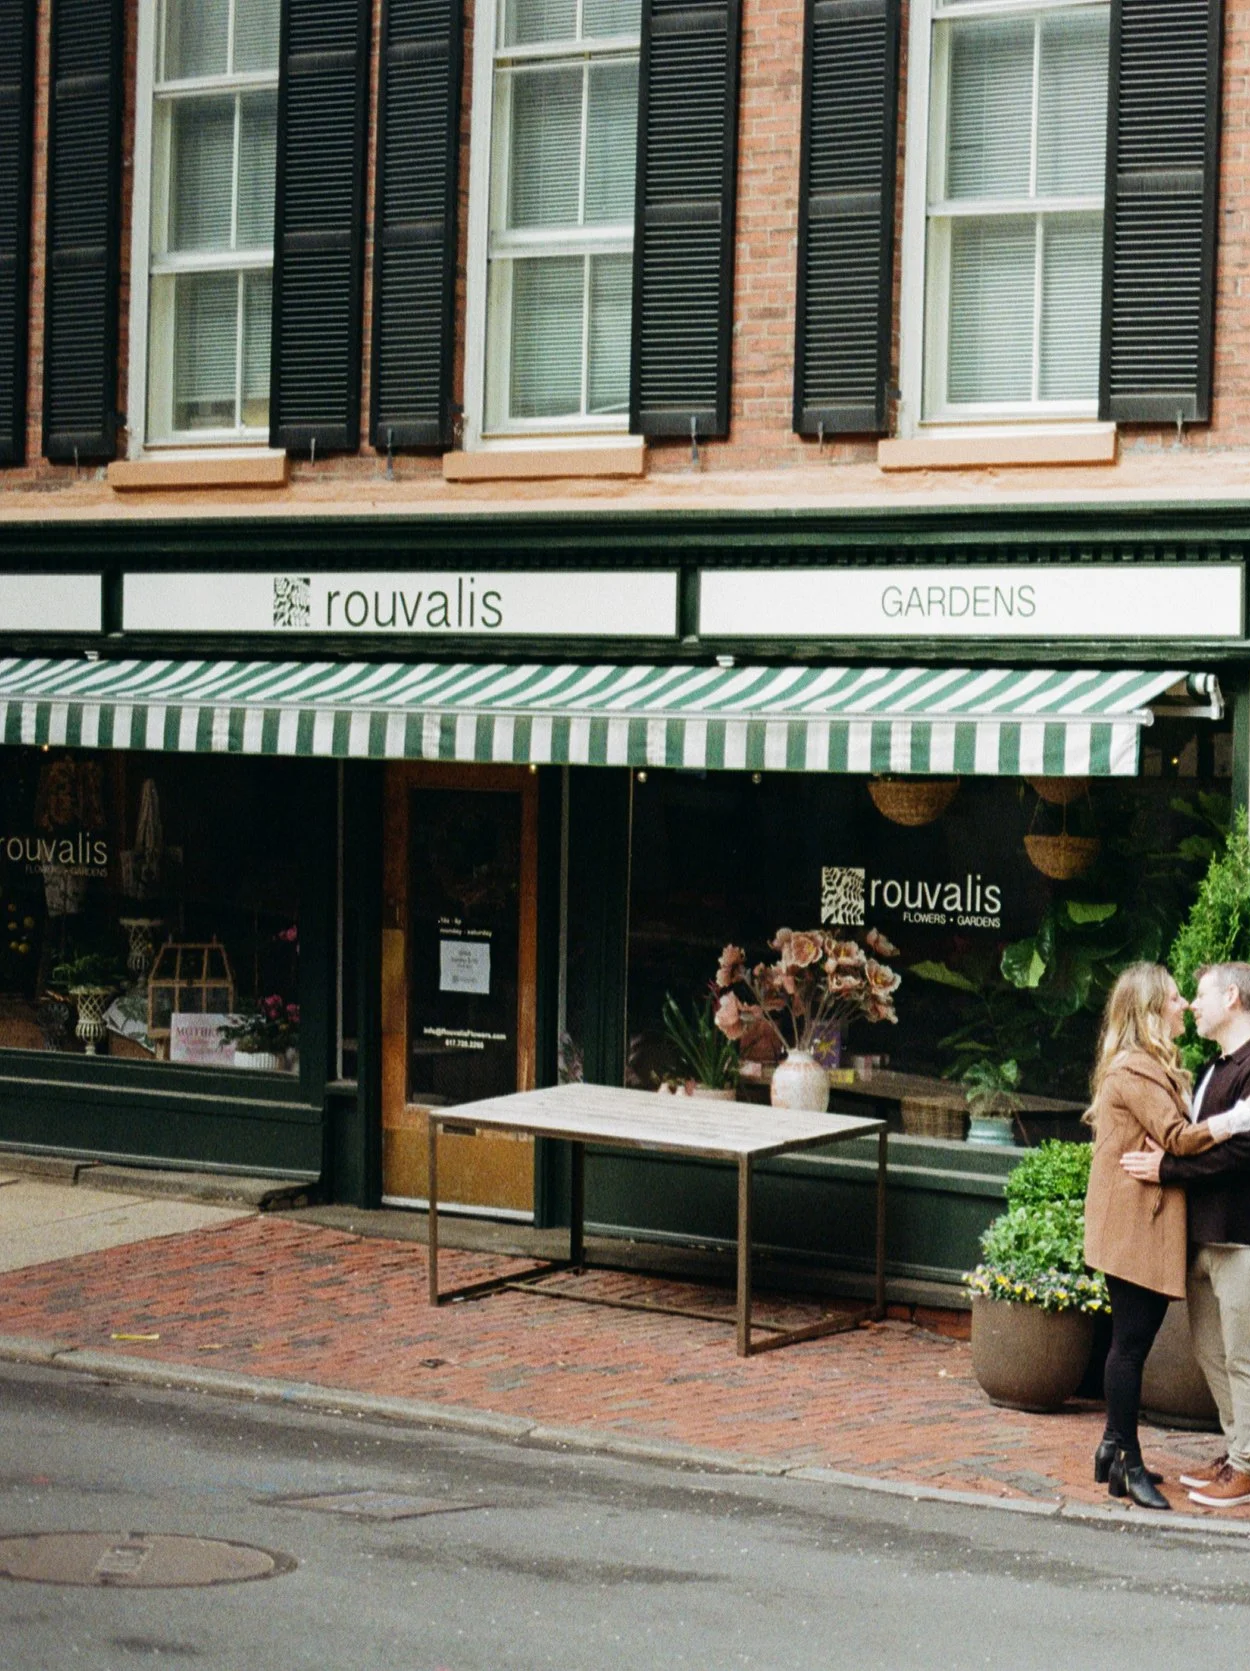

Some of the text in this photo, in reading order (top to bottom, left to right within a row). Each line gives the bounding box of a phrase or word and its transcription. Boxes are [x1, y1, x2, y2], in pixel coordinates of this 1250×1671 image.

[327, 577, 502, 628] rouvalis
[881, 585, 1036, 618] GARDENS
[870, 874, 1002, 914] rouvalis
[903, 911, 1001, 929] FLOWERS GARDENS
